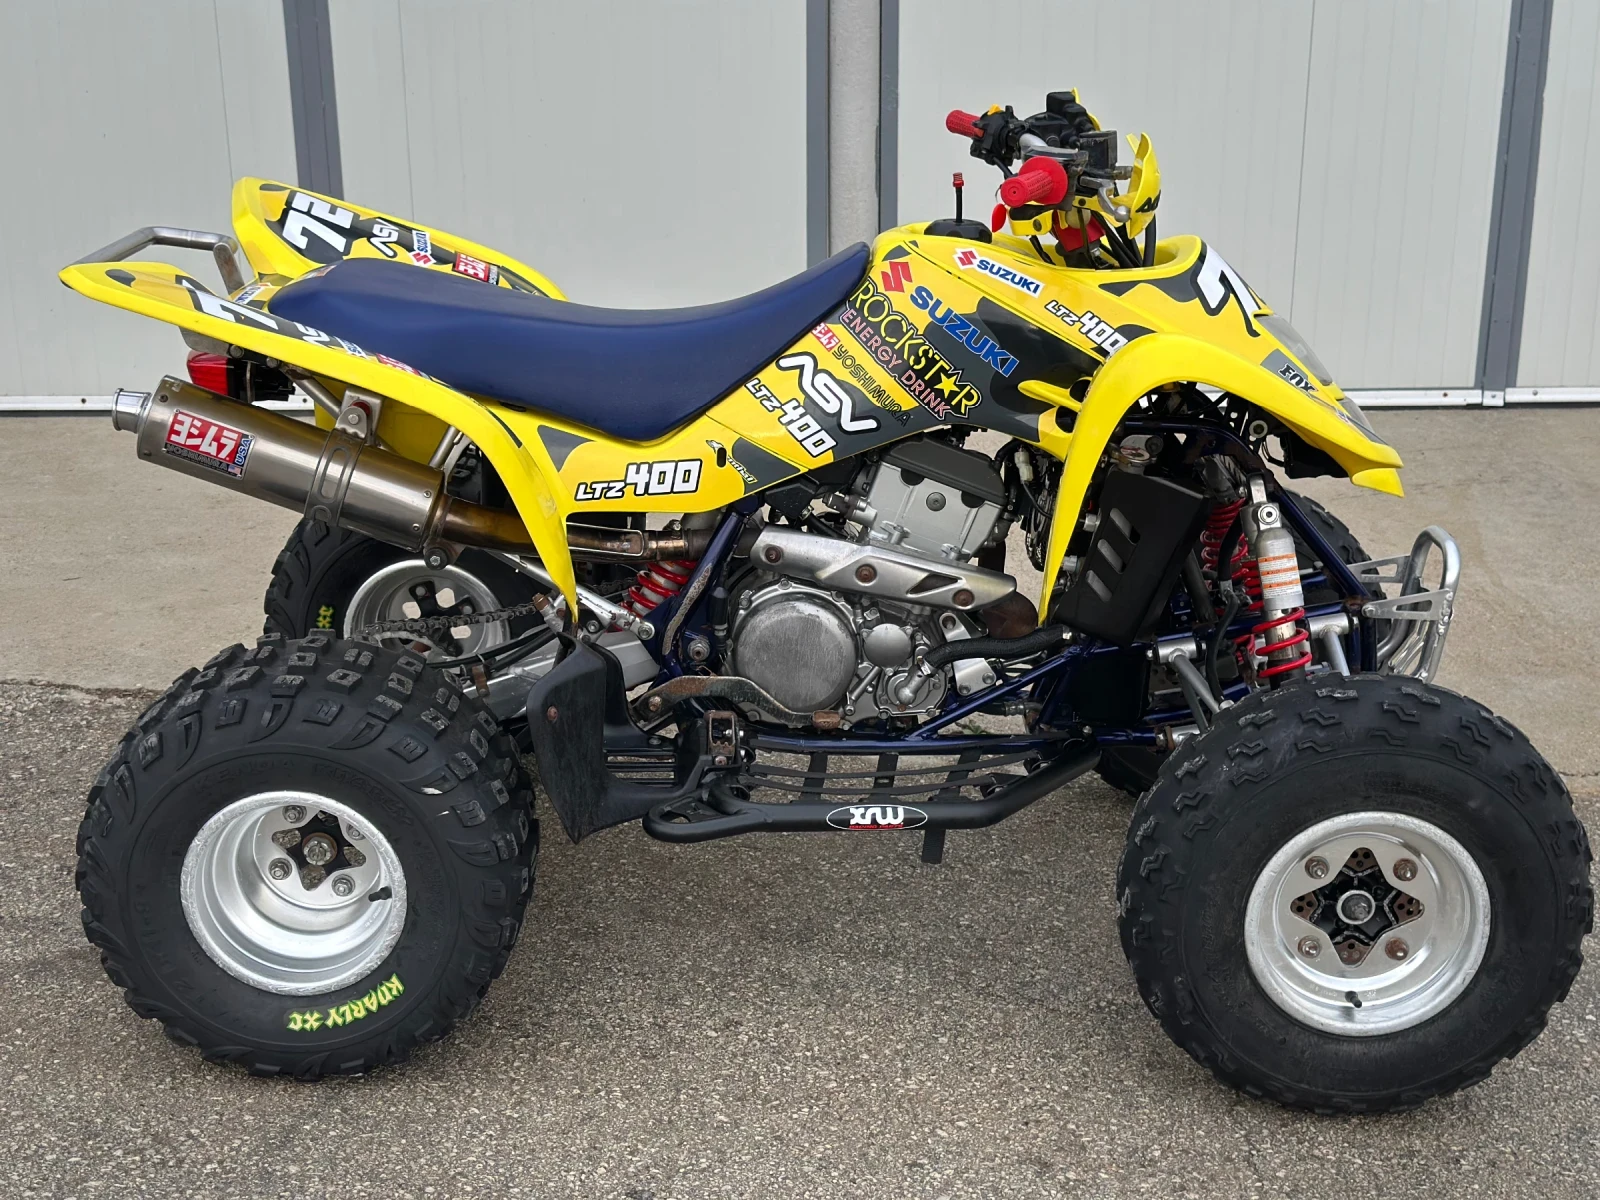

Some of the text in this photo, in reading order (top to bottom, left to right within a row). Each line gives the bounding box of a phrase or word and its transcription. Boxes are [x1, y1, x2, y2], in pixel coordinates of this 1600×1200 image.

[282, 192, 354, 252] 72
[976, 259, 1040, 295] SUZUKI
[910, 285, 1019, 377] SUZUKI
[777, 353, 880, 433] ASV
[832, 343, 912, 427] YOSHIMURA
[842, 309, 952, 418] ENERGY DRINK
[1278, 363, 1318, 393] FOX
[170, 413, 239, 459] ヨシムラ
[235, 438, 251, 466] USA
